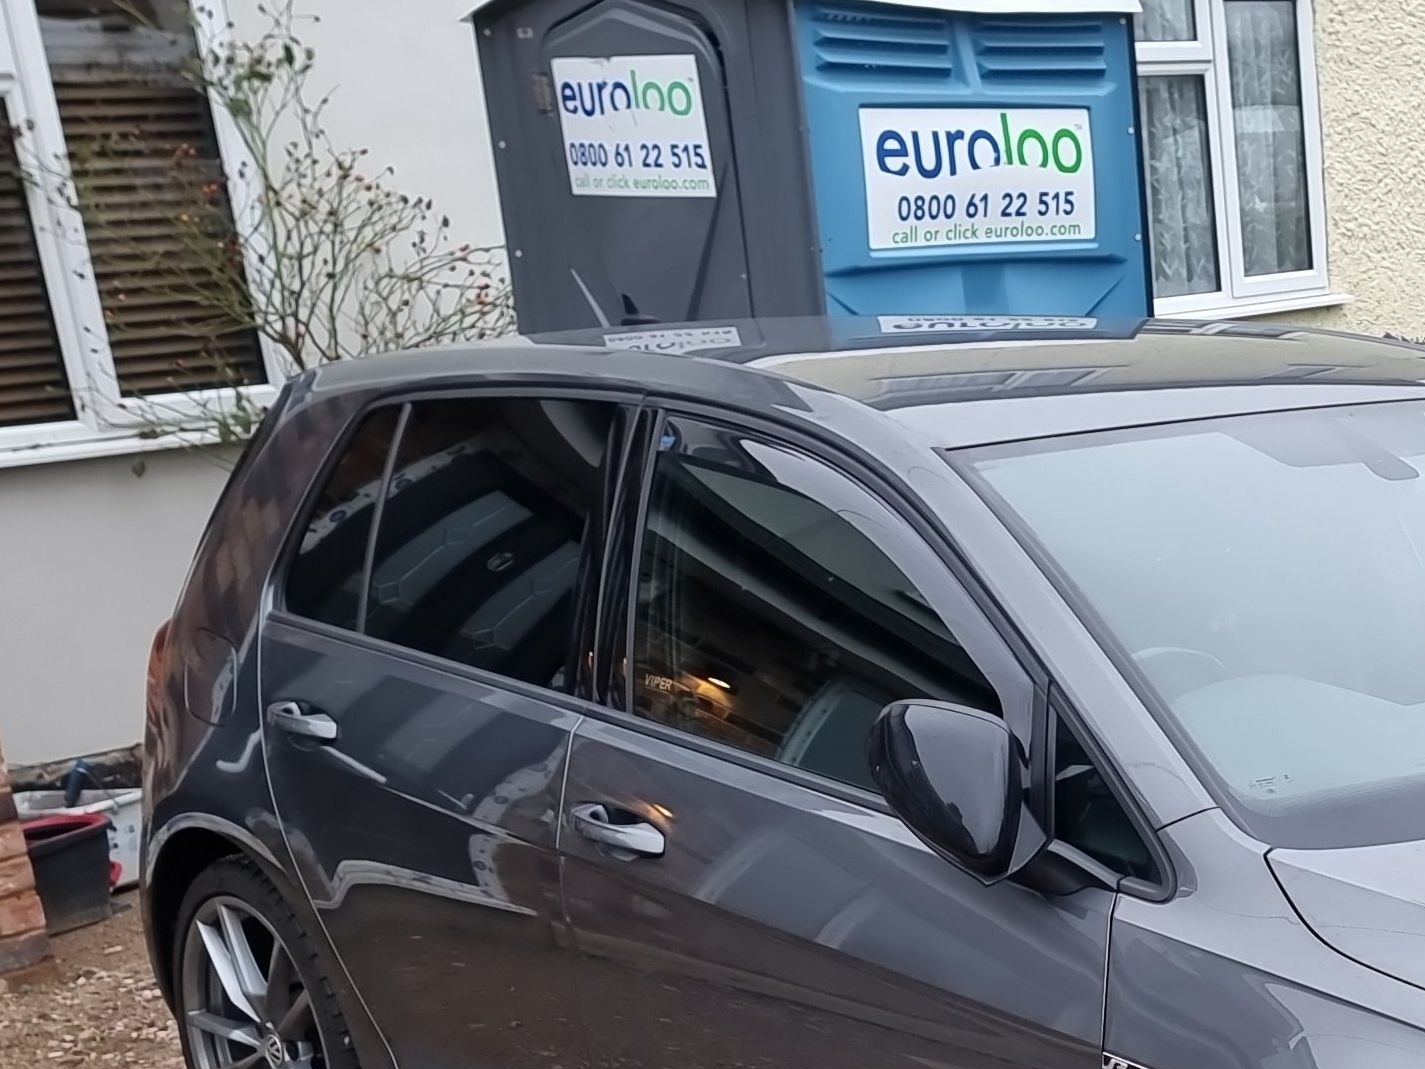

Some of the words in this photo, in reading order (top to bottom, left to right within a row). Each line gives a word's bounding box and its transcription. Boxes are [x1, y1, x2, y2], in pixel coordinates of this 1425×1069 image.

[561, 69, 692, 117] euroloo
[569, 142, 609, 168] 0800
[614, 143, 633, 168] 61
[640, 143, 664, 168] 22
[670, 144, 707, 169] 515
[876, 112, 1083, 179] euroloo
[575, 173, 591, 188] call
[593, 176, 604, 188] or
[607, 174, 630, 189] click
[633, 175, 710, 190] euroloo.com
[898, 195, 956, 221] 0800
[965, 193, 989, 218] 61
[1000, 192, 1027, 217] 22
[1037, 191, 1075, 216] 515
[892, 226, 918, 244] call
[923, 228, 940, 243] or
[945, 223, 979, 241] click
[985, 221, 1081, 239] euroloo.com
[645, 673, 673, 691] VIPER
